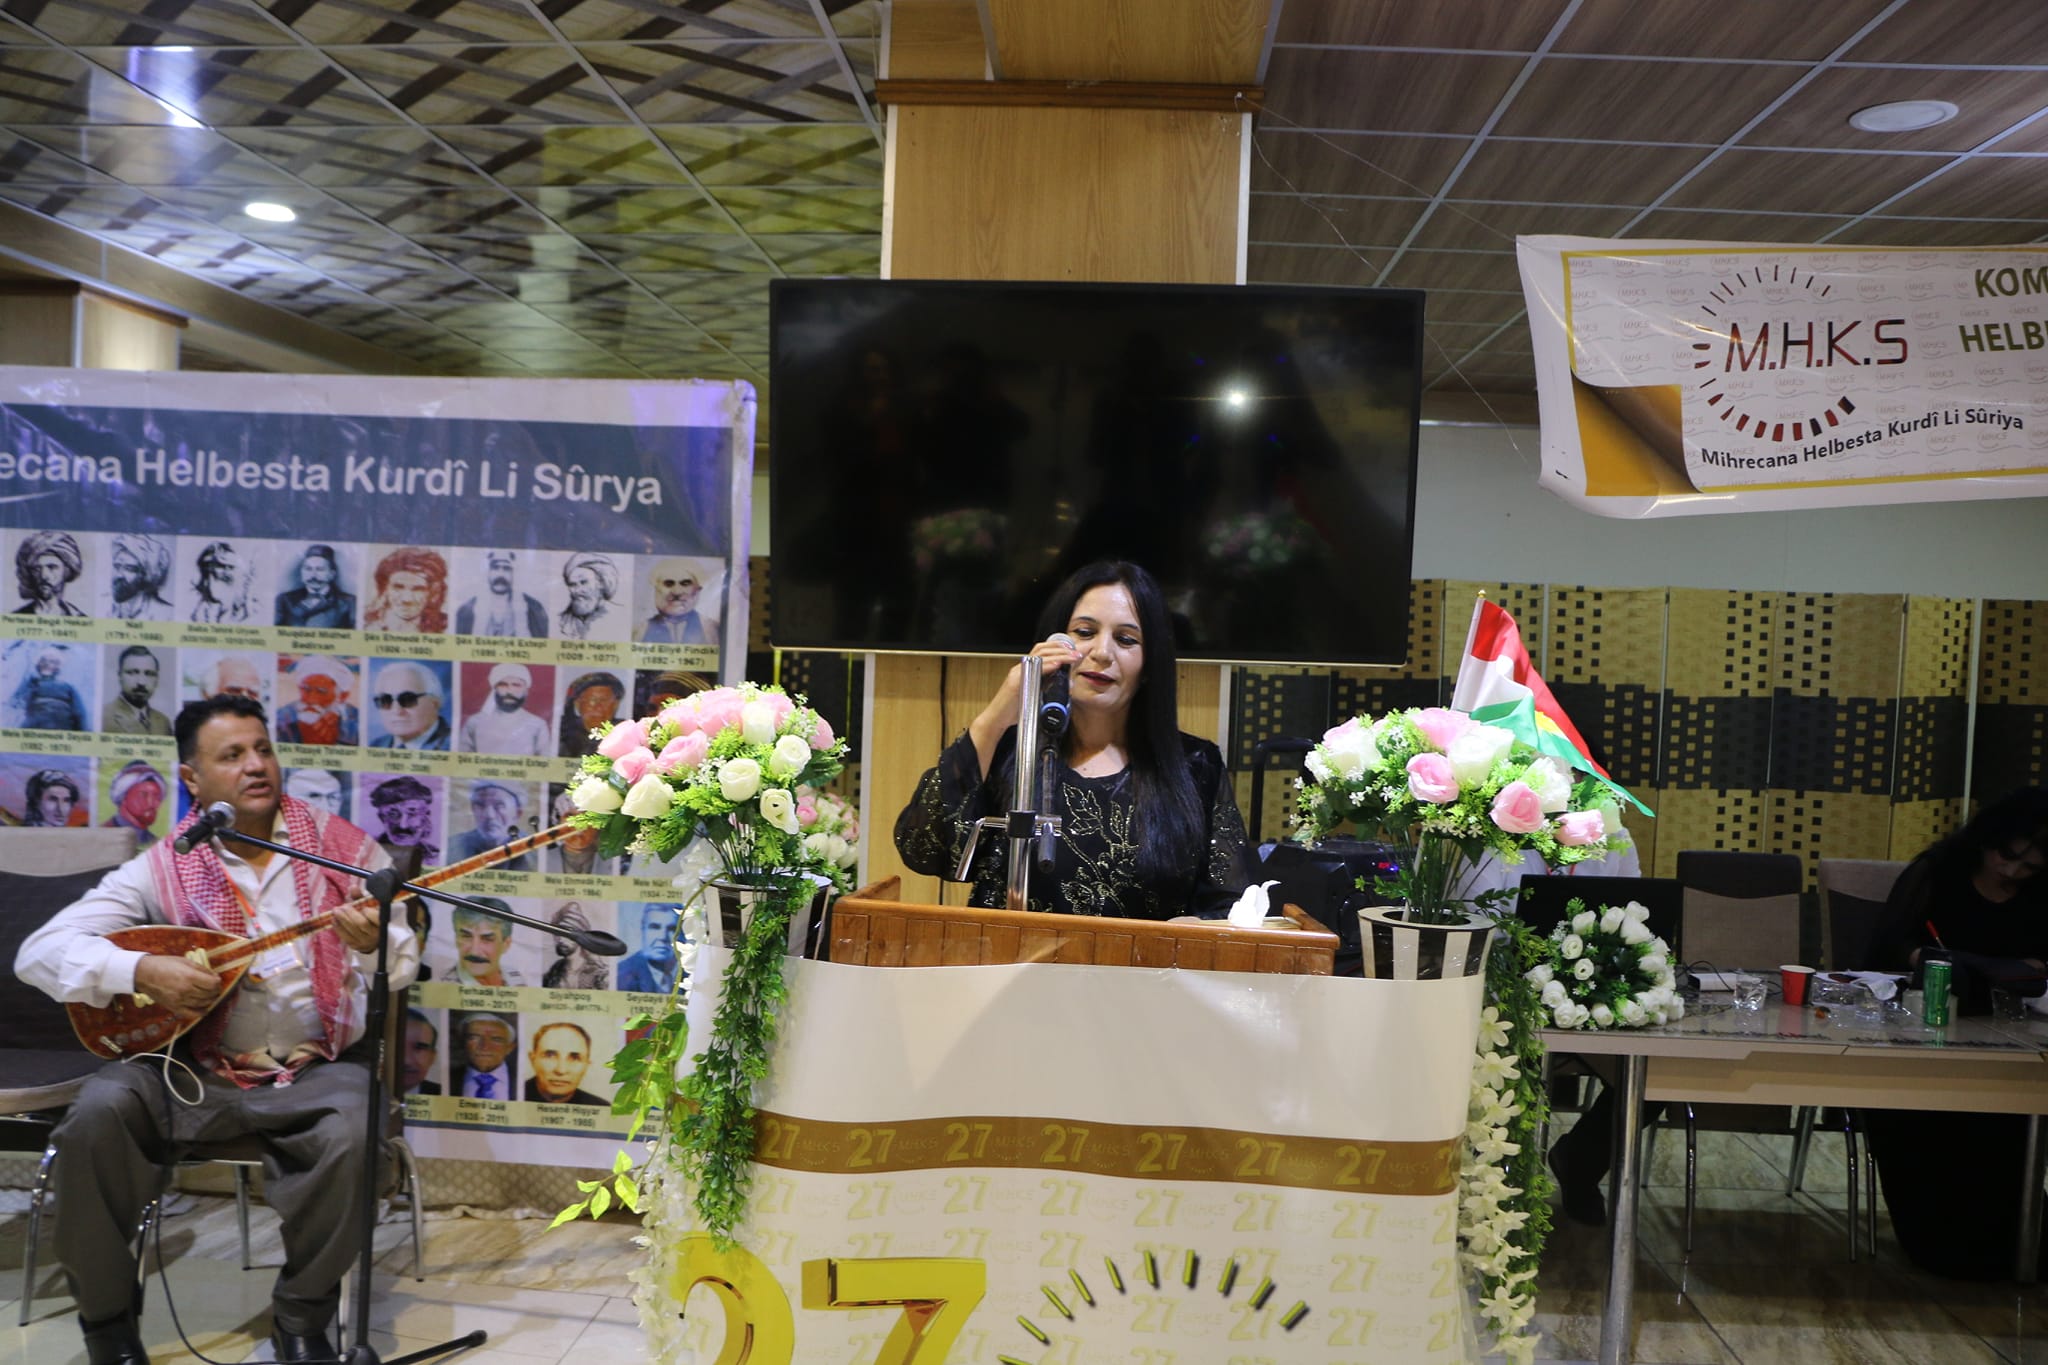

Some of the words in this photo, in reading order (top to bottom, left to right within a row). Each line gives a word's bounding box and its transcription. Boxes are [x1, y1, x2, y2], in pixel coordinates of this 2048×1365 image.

[1724, 319, 1908, 373] M.H.K.S
[1959, 320, 2048, 353] HELB
[1701, 447, 1798, 469] Mihrecana
[1803, 429, 1883, 463] Helbesta
[1888, 411, 1940, 438] Kurdî
[1944, 409, 1961, 426] Li
[1964, 408, 2024, 431] Sûriya
[136, 448, 331, 492] Helbesta
[344, 455, 468, 497] Kurdî
[480, 460, 518, 499] Li
[531, 462, 663, 513] Sûrya
[761, 1119, 801, 1161] 27
[847, 1127, 897, 1168] 27
[944, 1122, 994, 1163] 27
[1040, 1124, 1090, 1164] 27
[1135, 1131, 1188, 1174] 27
[1234, 1137, 1287, 1178] 27
[1333, 1145, 1387, 1186] 27
[847, 1180, 895, 1221] 27
[944, 1175, 992, 1216] 27
[1039, 1176, 1089, 1217] 27
[1134, 1187, 1184, 1228] 27
[1232, 1191, 1283, 1232] 27
[1332, 1199, 1384, 1240] 27
[1330, 1253, 1382, 1293] 27
[1328, 1306, 1377, 1347] 27
